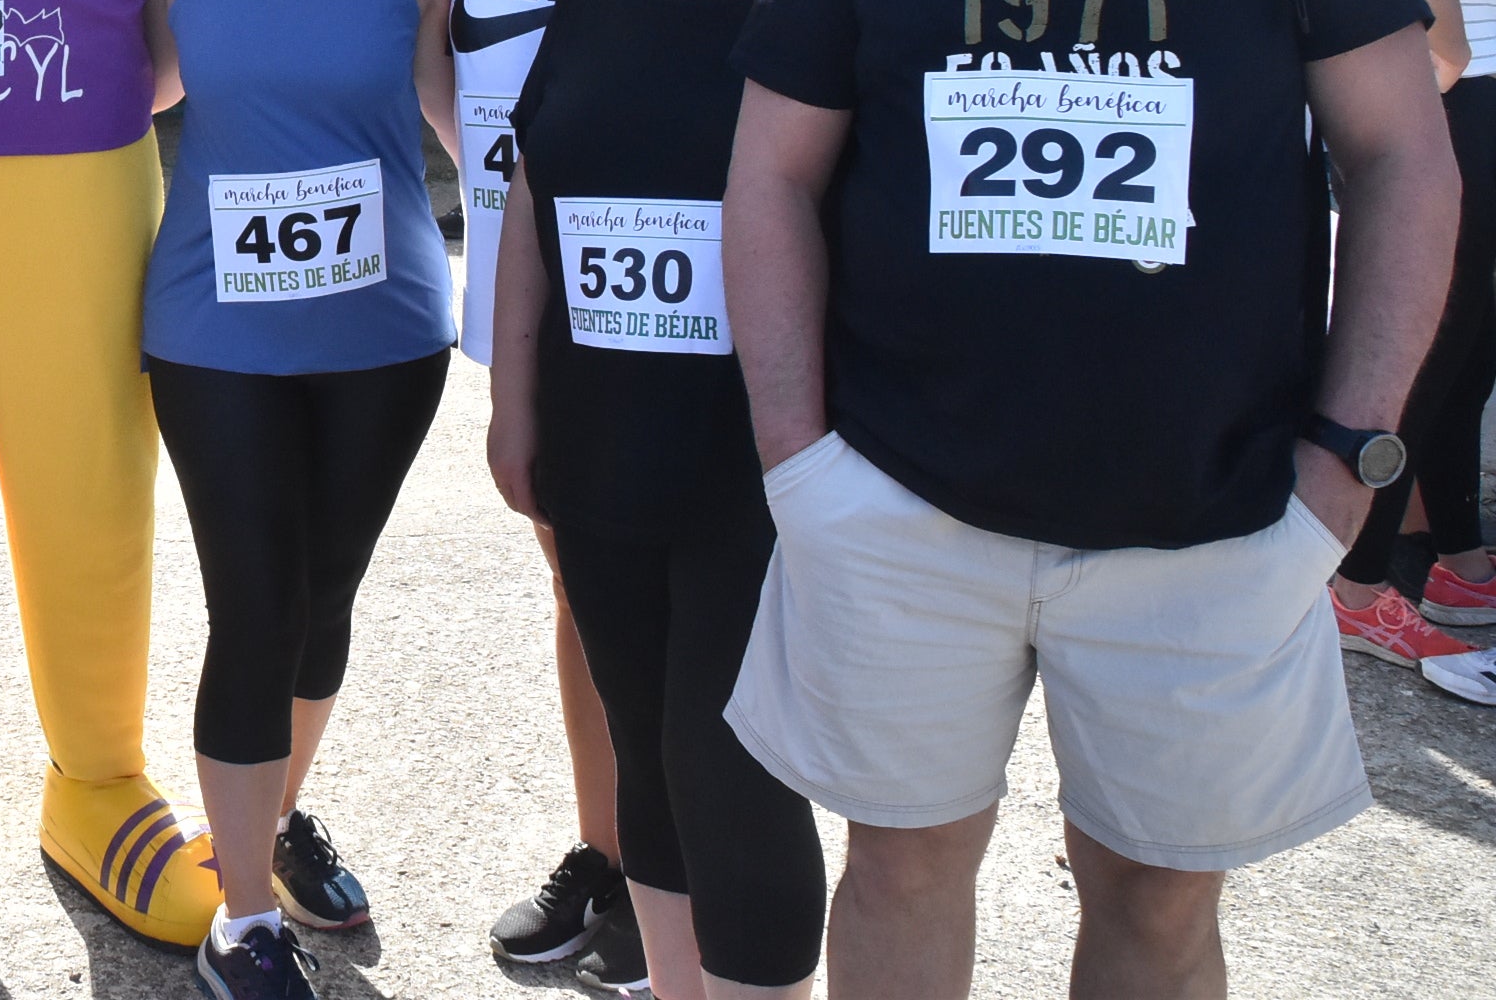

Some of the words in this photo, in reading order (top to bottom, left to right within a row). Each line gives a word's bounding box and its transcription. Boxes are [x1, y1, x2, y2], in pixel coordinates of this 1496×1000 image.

[947, 81, 1048, 114] marcha
[1055, 84, 1167, 119] benéfica
[959, 126, 1158, 204] 292
[224, 182, 289, 206] marcha
[295, 176, 366, 201] benéfica
[235, 202, 362, 264] 467
[568, 206, 627, 232] marcha
[632, 207, 710, 236] benéfica
[938, 209, 1043, 240] FUENTES
[1051, 210, 1085, 242] DE
[1093, 208, 1177, 249] BÉJAR
[223, 270, 300, 294] FUENTES
[303, 266, 328, 289] DE
[331, 253, 381, 285] BÉJAR
[579, 246, 693, 304] 530
[570, 306, 623, 336] FUENTES
[625, 311, 650, 337] DE
[653, 309, 719, 341] BÉJAR
